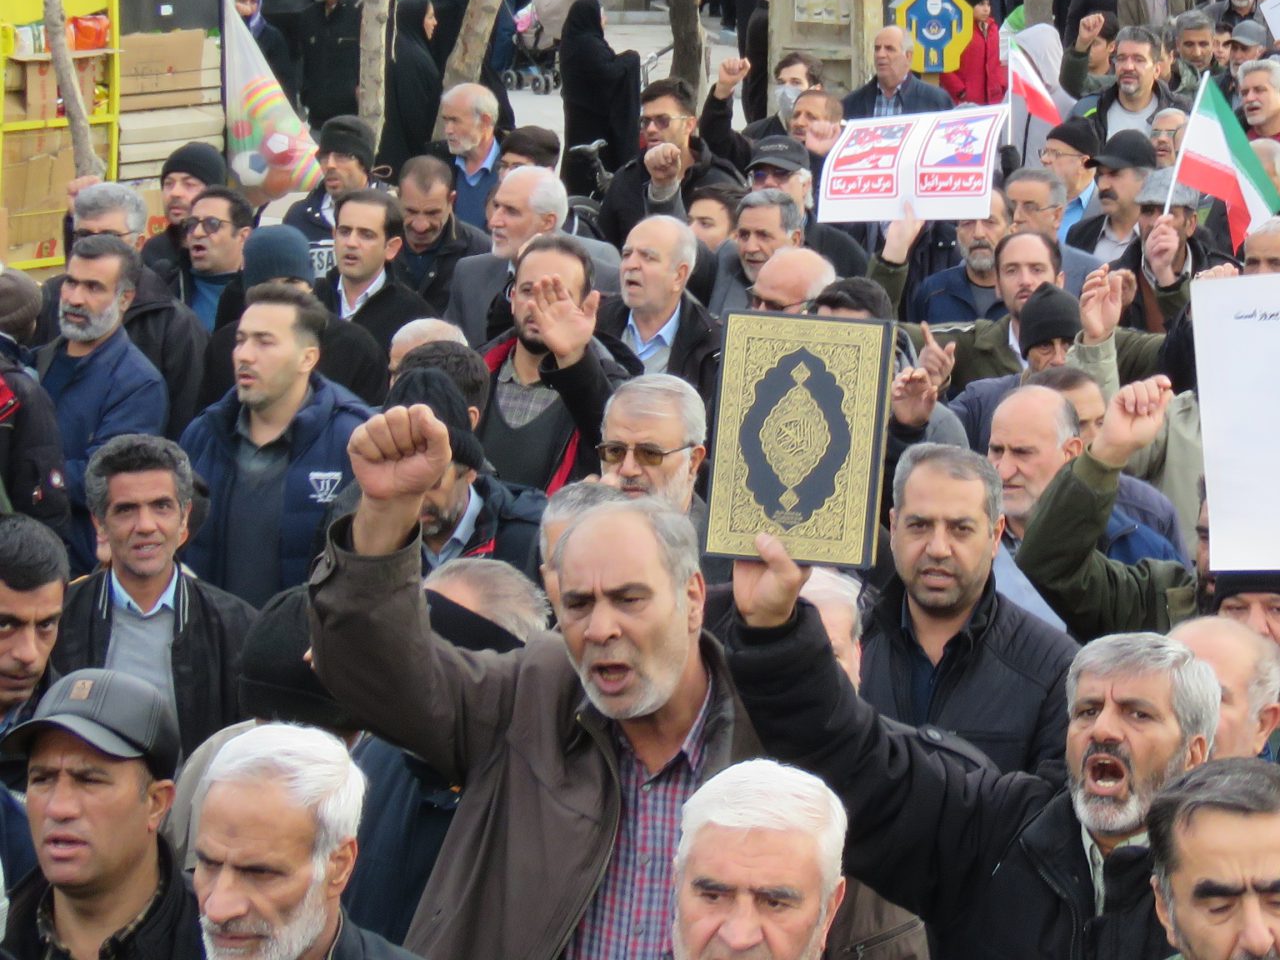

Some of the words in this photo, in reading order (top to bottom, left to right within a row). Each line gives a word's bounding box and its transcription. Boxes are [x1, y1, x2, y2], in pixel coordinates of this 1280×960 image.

[832, 176, 861, 193] آمریکا
[861, 179, 871, 193] بر
[871, 176, 891, 191] مرگ
[920, 175, 953, 191] اسرائیل
[963, 175, 983, 191] مرگ
[1233, 309, 1256, 320] است
[1258, 309, 1280, 321] پیروز
